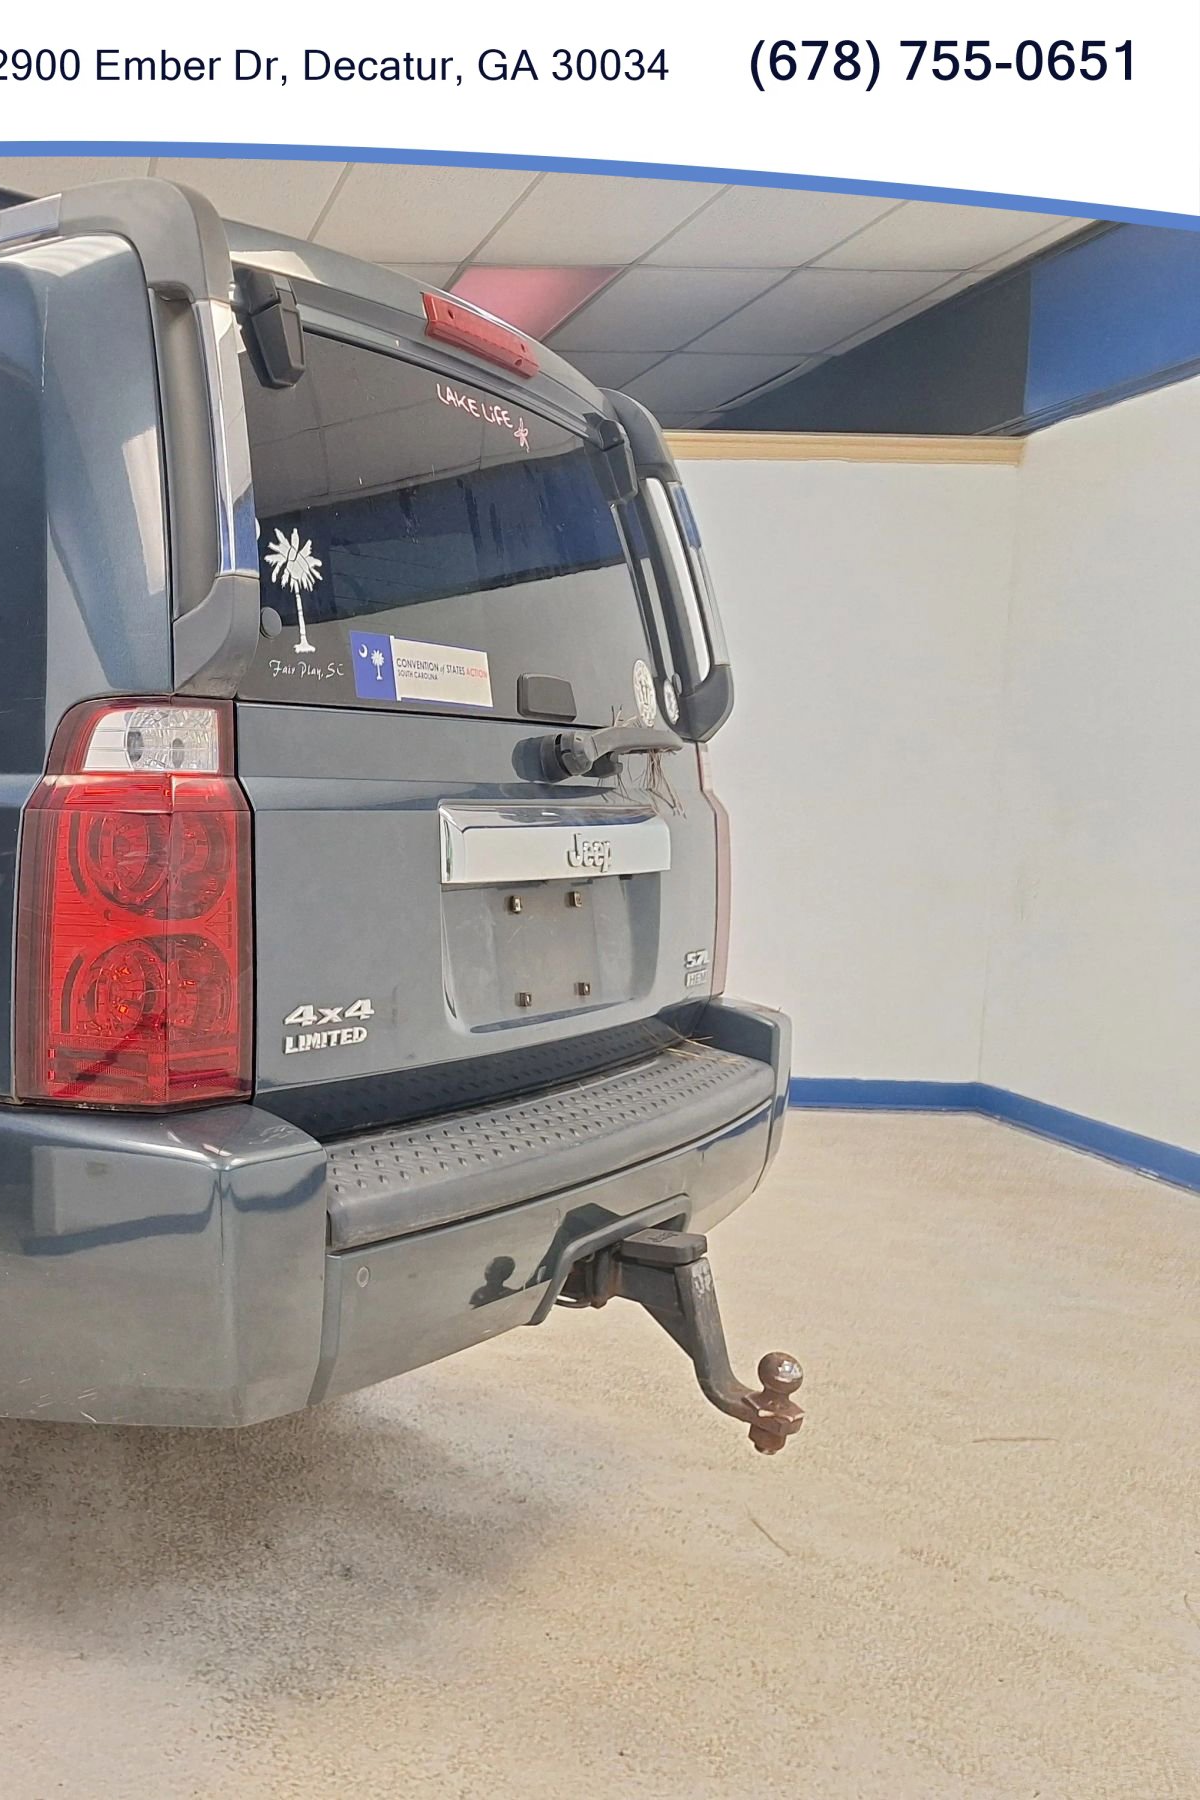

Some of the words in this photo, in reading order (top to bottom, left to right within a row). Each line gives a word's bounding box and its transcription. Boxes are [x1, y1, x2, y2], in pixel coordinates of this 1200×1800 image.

[436, 383, 481, 418] LAKE
[268, 659, 296, 677] Fair
[325, 662, 344, 679] SC
[396, 658, 439, 672] CONVENTION
[446, 664, 465, 676] STATES
[466, 667, 488, 679] ACTION
[397, 669, 413, 679] SOUTH
[413, 671, 439, 681] CAROLINA
[567, 832, 611, 873] Jeep
[283, 998, 375, 1028] 4x4
[283, 1026, 368, 1055] LIMITED
